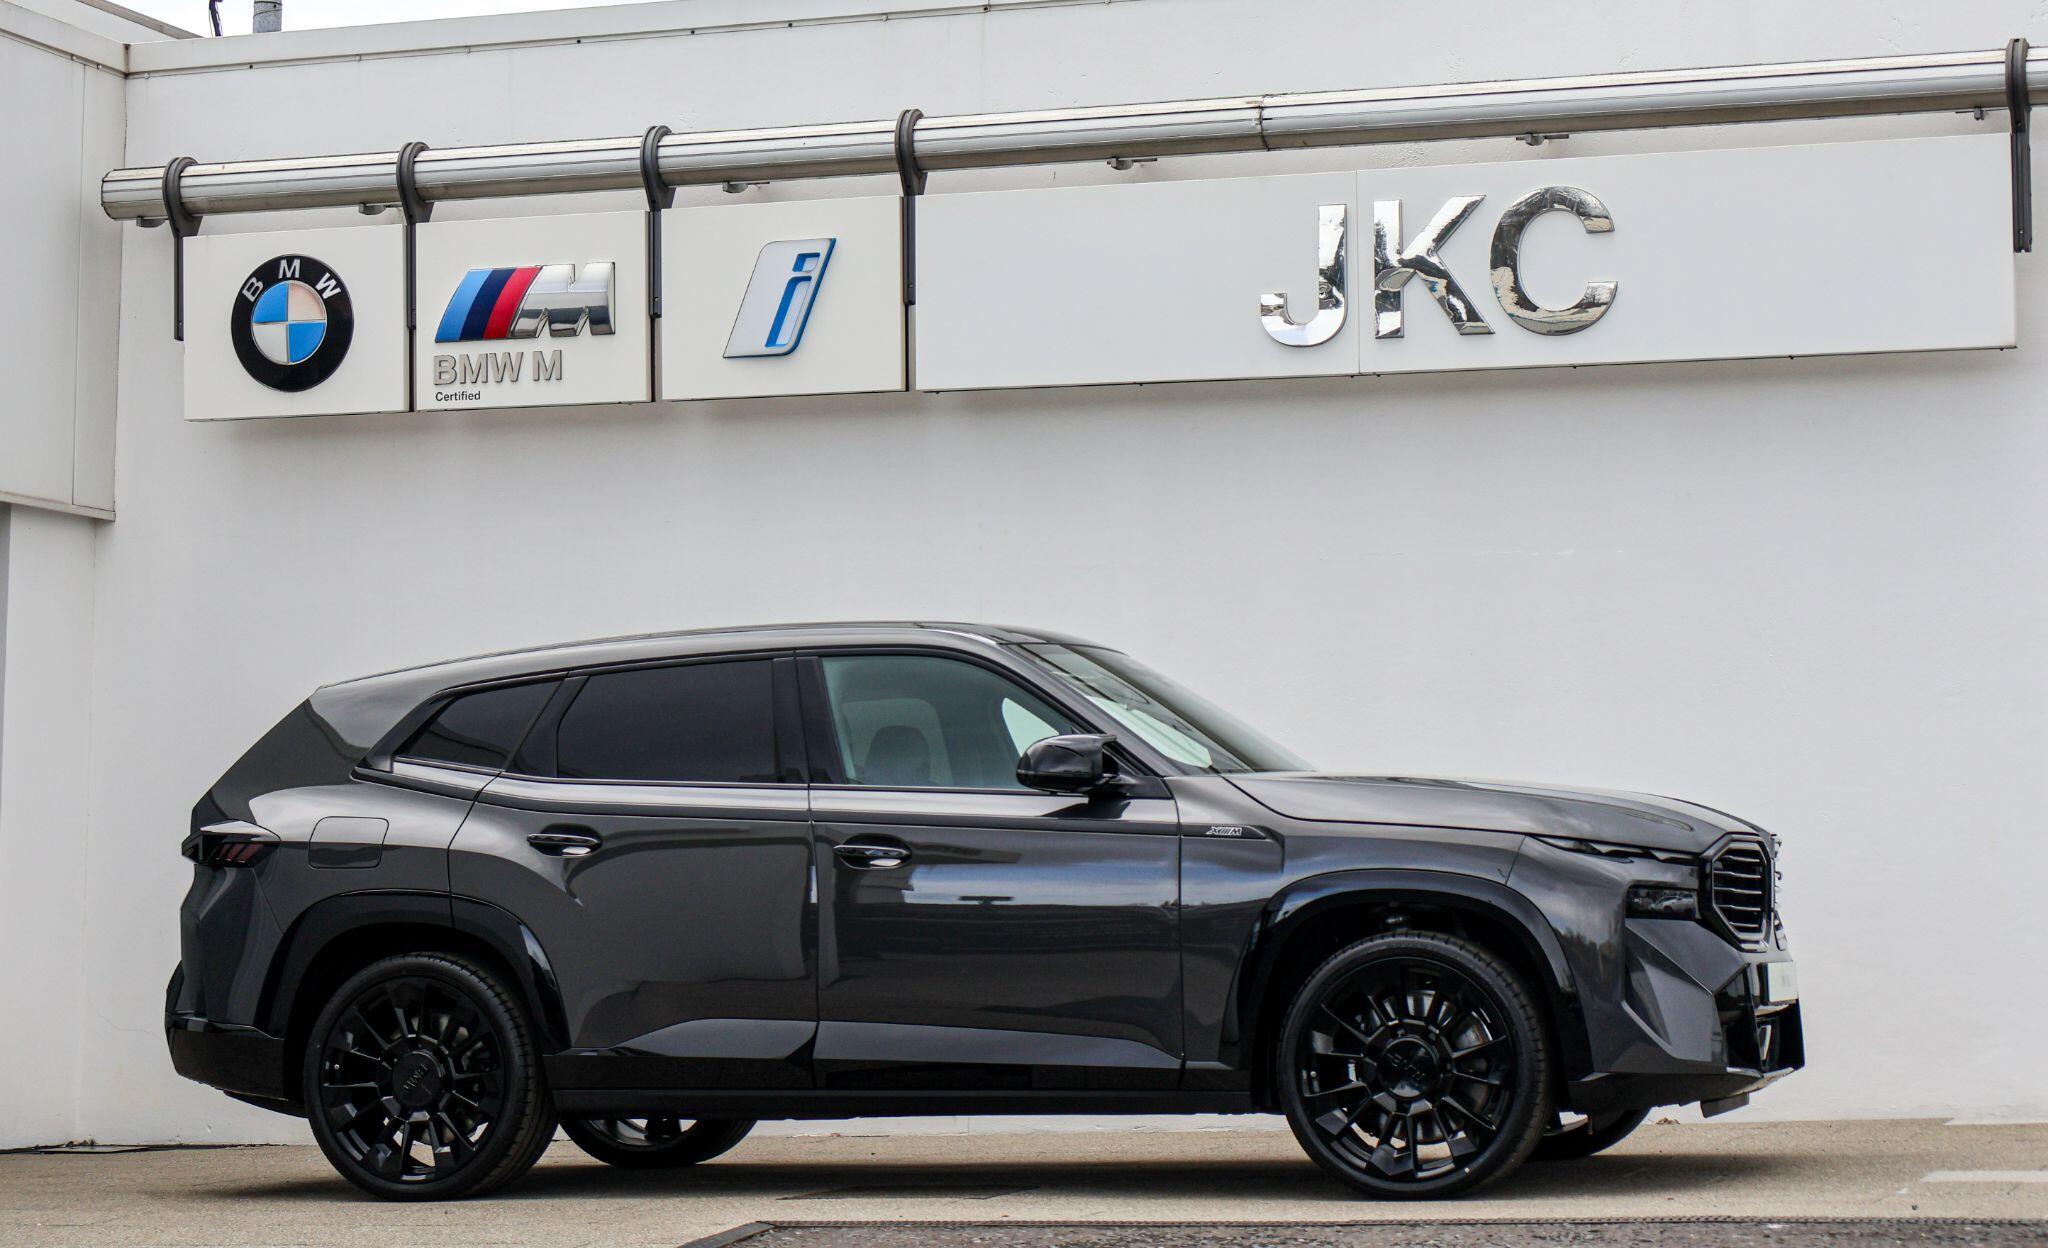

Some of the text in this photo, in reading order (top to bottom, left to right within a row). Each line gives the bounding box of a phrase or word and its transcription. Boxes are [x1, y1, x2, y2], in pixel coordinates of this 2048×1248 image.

[241, 258, 342, 303] BMW
[1260, 186, 1618, 347] JKC
[433, 350, 563, 385] BMW M
[435, 391, 481, 402] Certified
